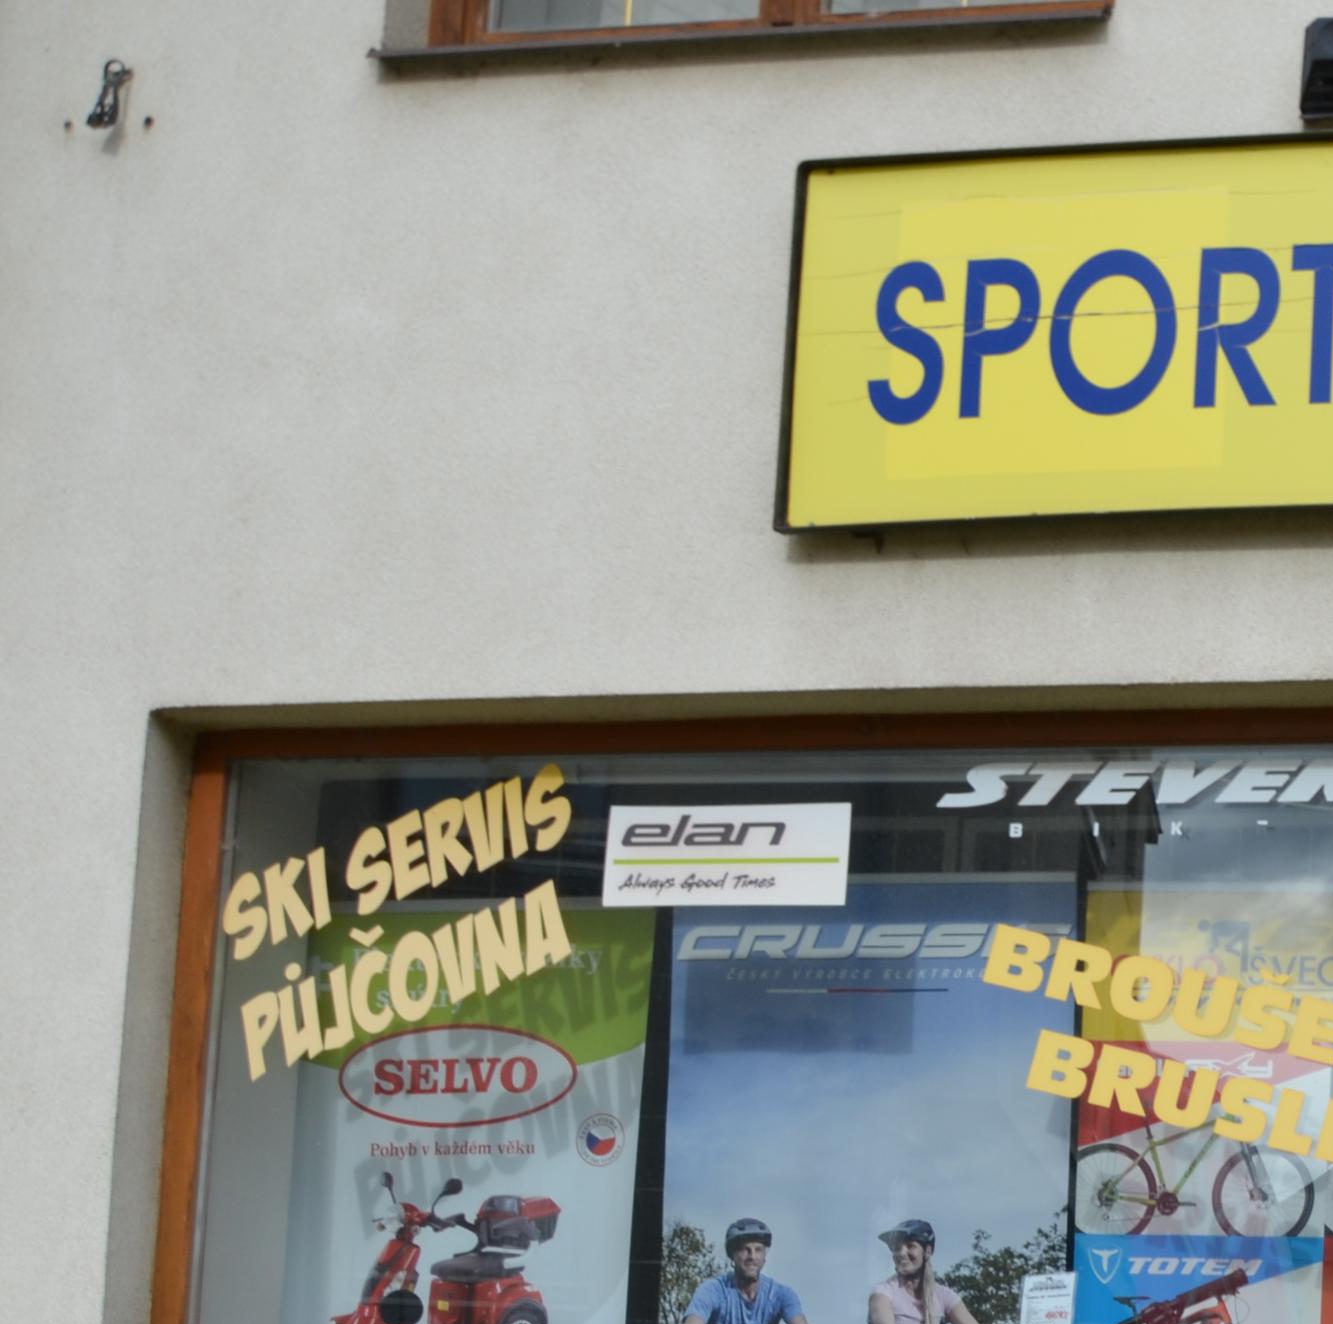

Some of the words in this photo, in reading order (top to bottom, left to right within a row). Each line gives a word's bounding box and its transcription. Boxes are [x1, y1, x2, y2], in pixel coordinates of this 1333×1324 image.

[621, 814, 787, 847] elan
[221, 847, 331, 961] SKI
[345, 762, 573, 917] SERVIS
[618, 872, 676, 896] Always
[680, 871, 729, 893] Good
[239, 879, 573, 1083] PŮJČOVNA
[373, 1055, 539, 1097] SELVO
[370, 1142, 417, 1159] Pohyb
[422, 1146, 430, 1155] v
[434, 1142, 492, 1157] každém
[497, 1142, 536, 1156] věku
[1128, 1256, 1264, 1277] TOTEM
